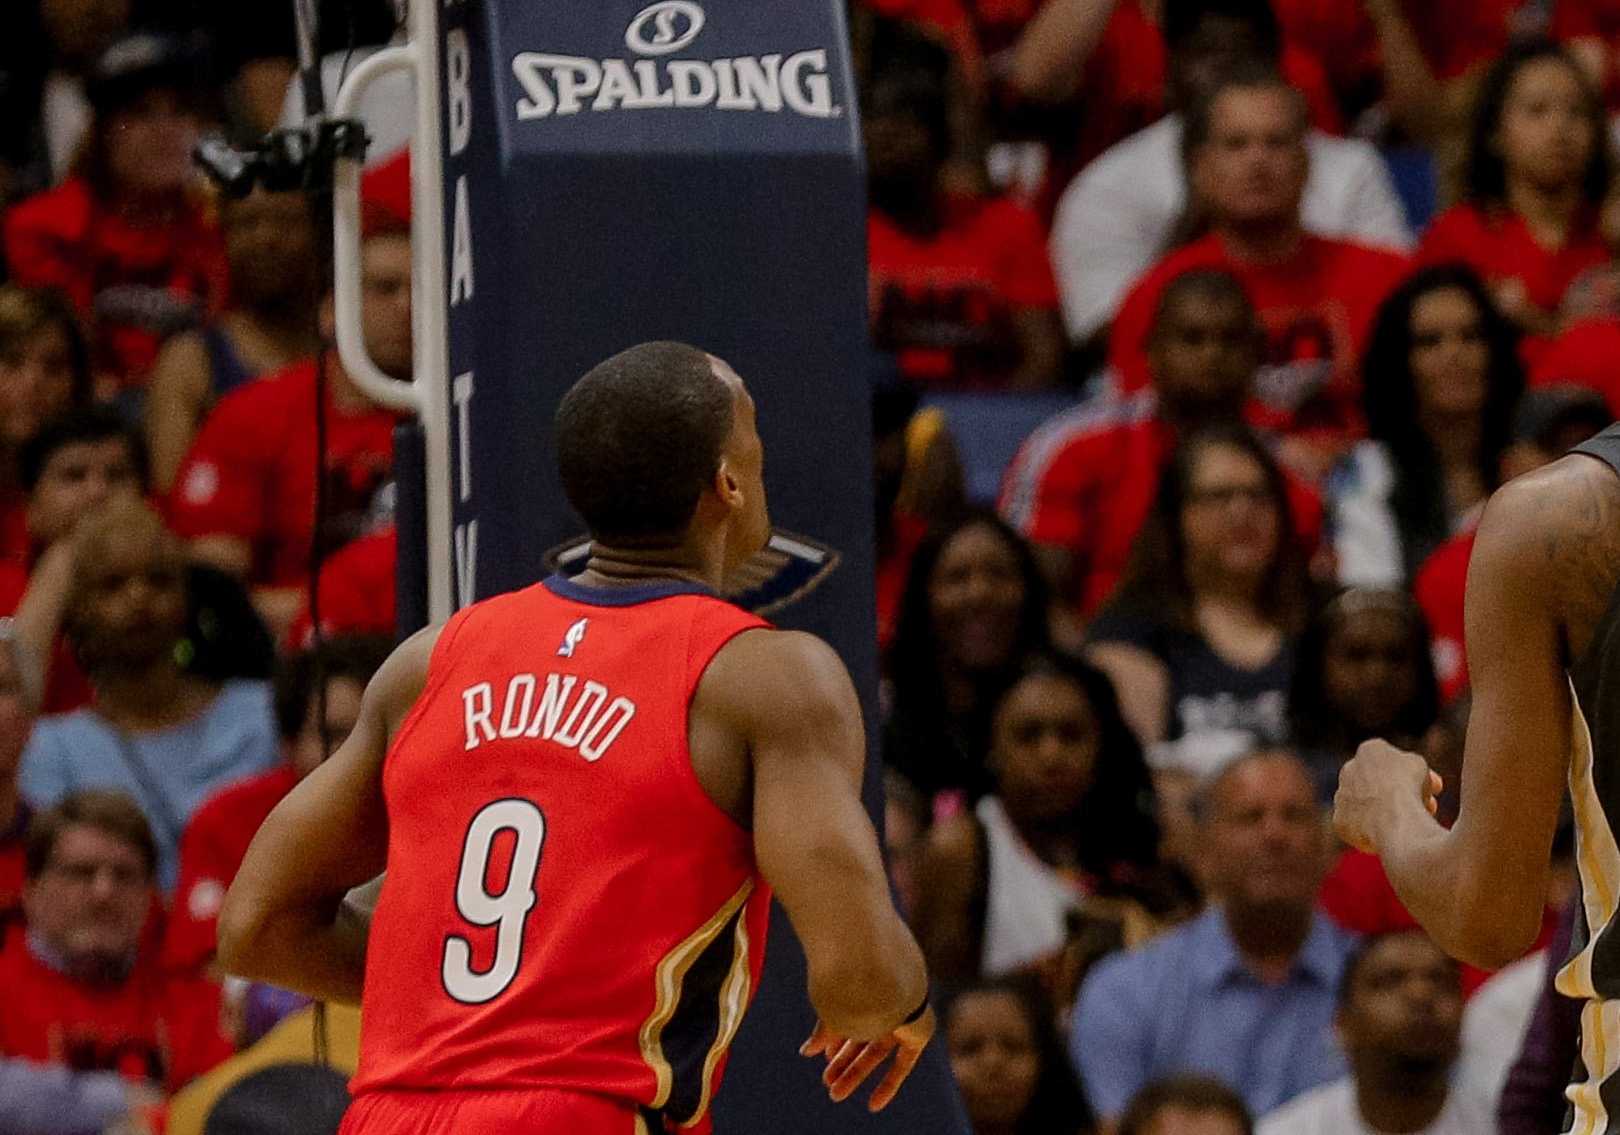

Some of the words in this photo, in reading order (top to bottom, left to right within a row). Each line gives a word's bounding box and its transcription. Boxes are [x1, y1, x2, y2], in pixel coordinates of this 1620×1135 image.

[512, 49, 833, 122] SPALDING
[462, 673, 636, 762] RONDO
[442, 798, 548, 1004] 9
